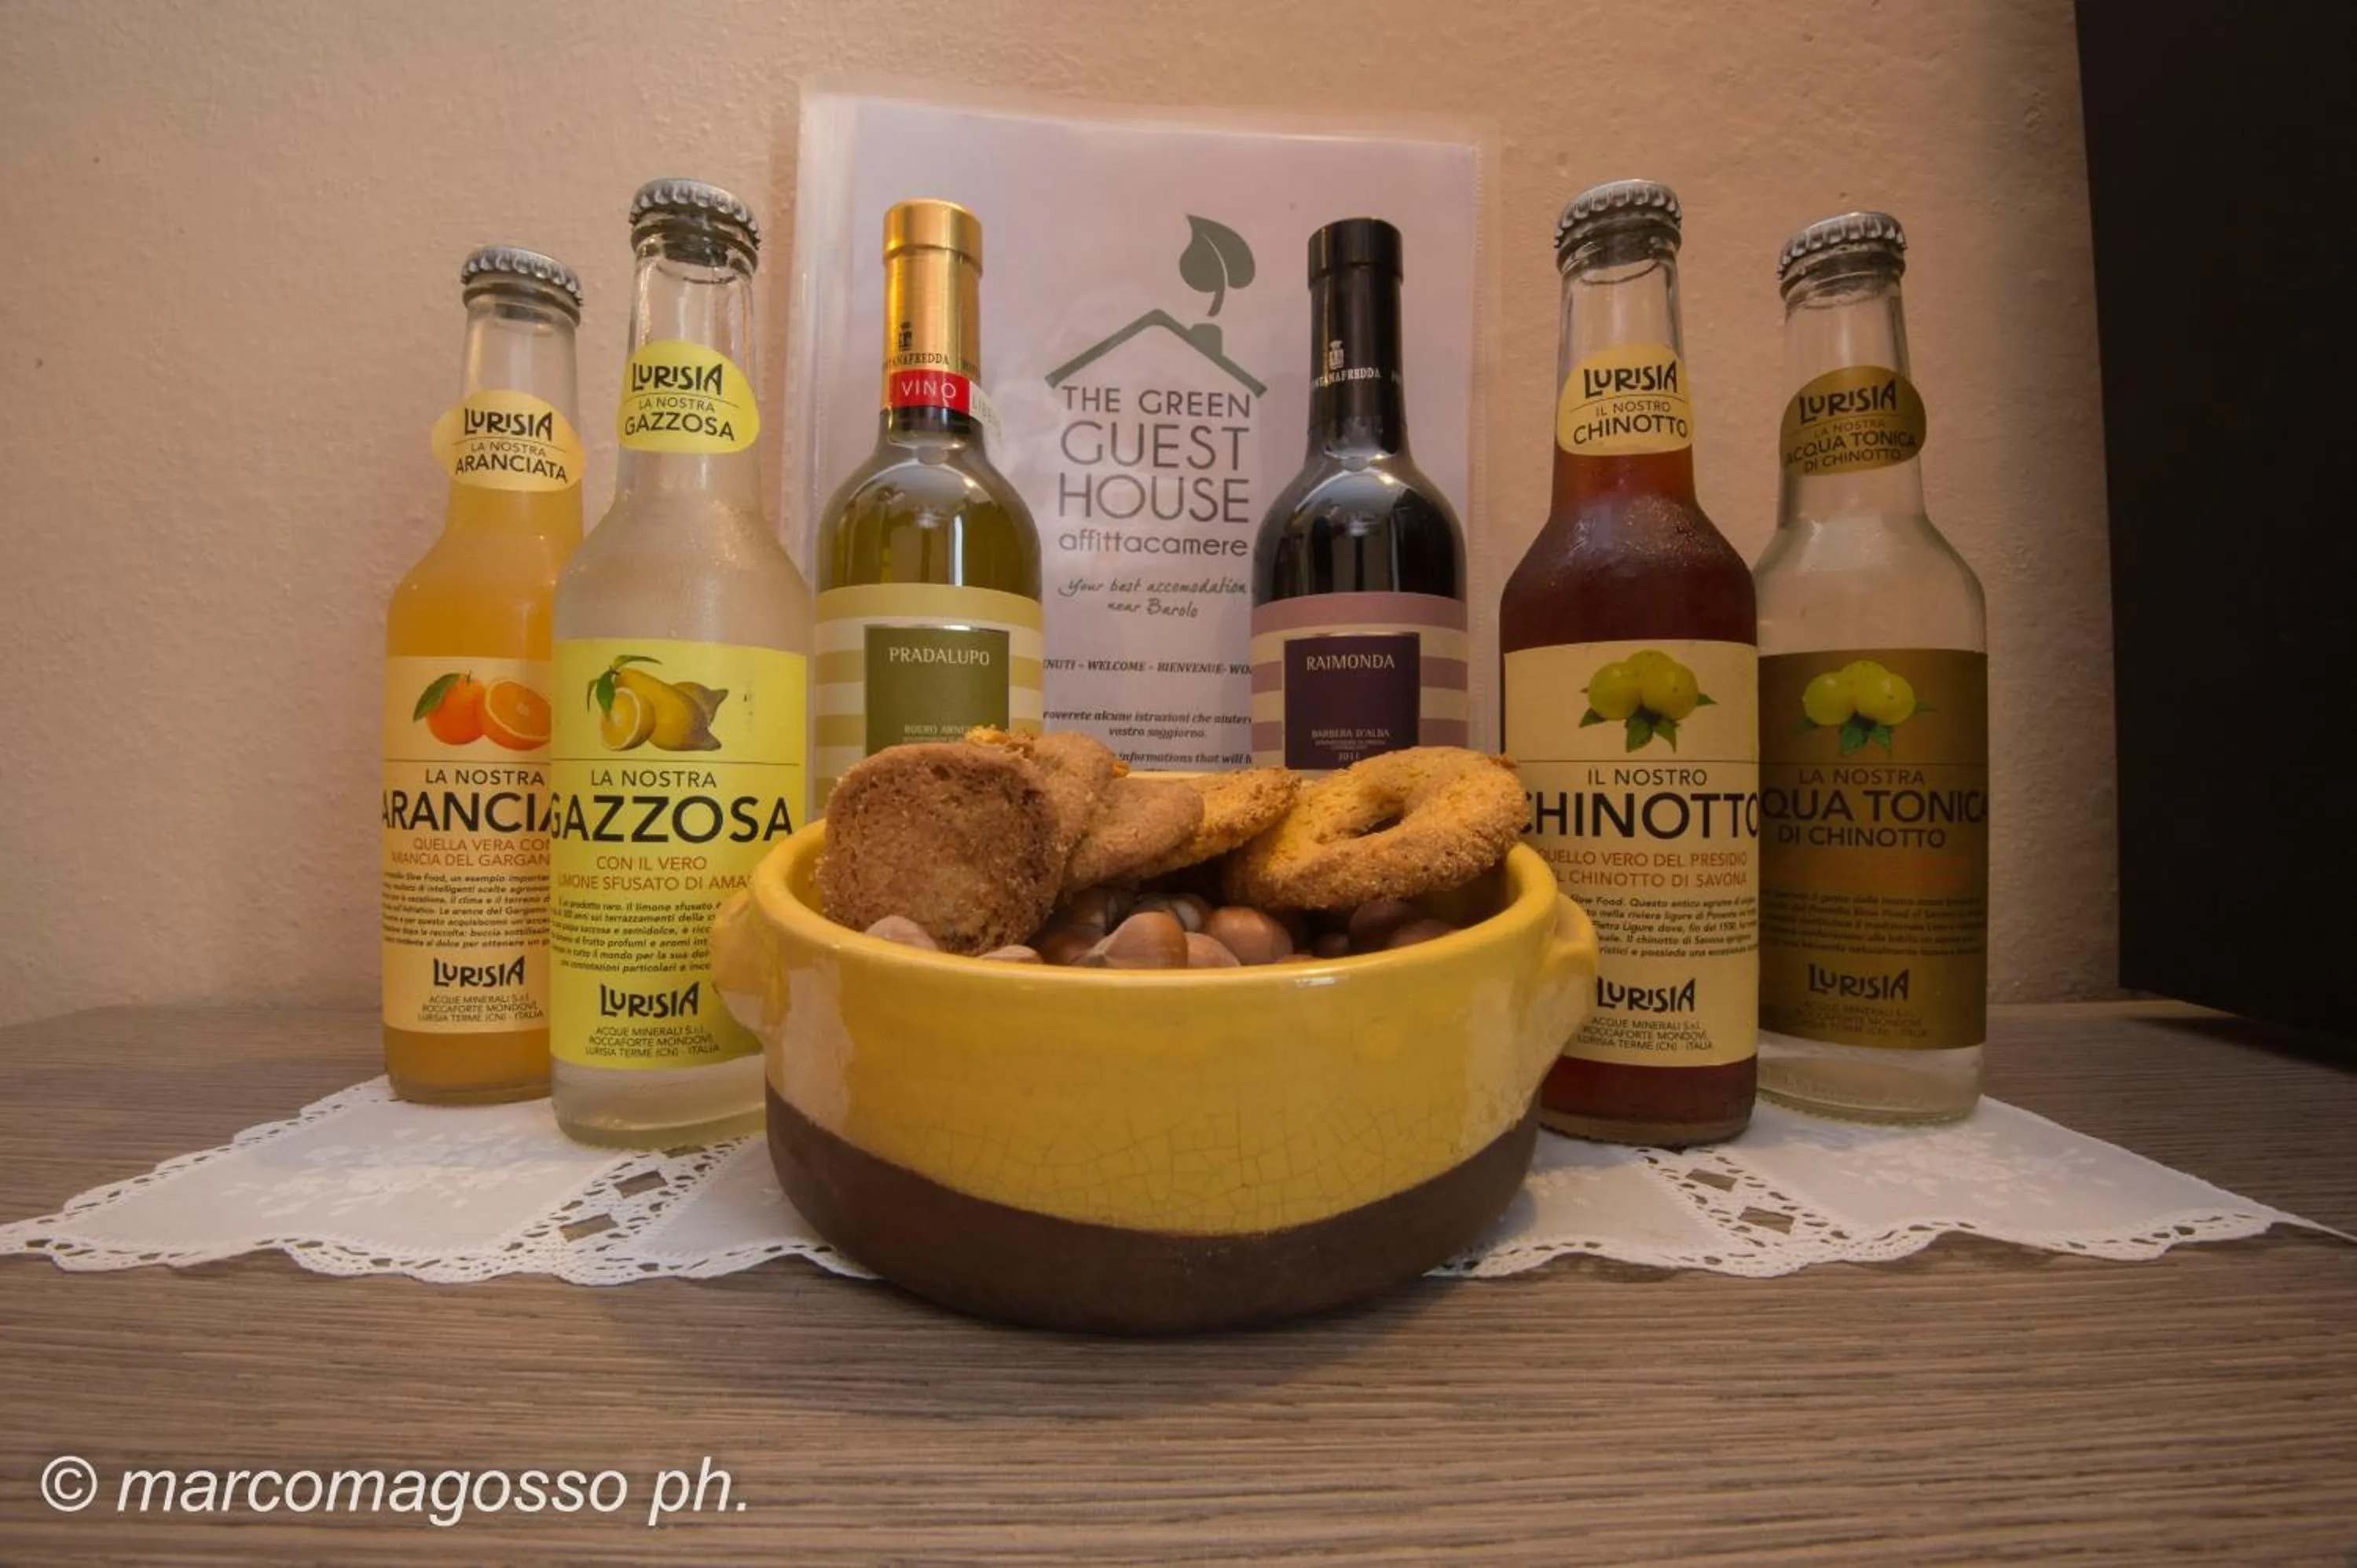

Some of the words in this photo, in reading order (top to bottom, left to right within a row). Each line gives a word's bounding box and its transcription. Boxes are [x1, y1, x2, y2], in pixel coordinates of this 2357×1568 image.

[632, 362, 723, 396] LURISIA
[1583, 360, 1678, 399] LURISIA
[901, 379, 956, 399] VINO
[639, 398, 653, 410] LA
[656, 396, 715, 412] NOSTRA
[1061, 385, 1121, 413] THE
[1138, 390, 1250, 419] GREEN
[1596, 406, 1607, 417] IL
[1613, 401, 1672, 414] NOSTRO
[1799, 378, 1897, 424] LURISIA
[464, 407, 553, 441] LURISIA
[625, 411, 736, 441] GAZZOSA
[1574, 414, 1688, 445] CHINOTTO
[1834, 418, 1886, 434] NOSTRA
[471, 442, 485, 452] LA
[489, 440, 547, 457] NOSTRA
[1061, 420, 1251, 471] GUEST
[1849, 430, 1917, 449] TONICA
[1822, 449, 1901, 467] CHINOTTO
[455, 453, 568, 484] ARANCIATA
[1059, 471, 1250, 523] HOUSE
[1058, 529, 1248, 557] affittacamere
[1110, 578, 1142, 593] best
[1108, 602, 1142, 614] near
[1146, 598, 1199, 618] Barolo
[889, 647, 990, 666] PRADALUPO
[1088, 660, 1146, 672] WELCOME
[1307, 654, 1395, 671] RAIMONDA
[1192, 712, 1211, 724] che
[1195, 752, 1219, 763] that
[1222, 753, 1243, 764] will
[425, 768, 447, 784] LA
[455, 768, 545, 786] NOSTRA
[591, 770, 614, 786] LA
[621, 770, 717, 789] NOSTRA
[1588, 768, 1606, 786] IL
[1614, 768, 1708, 786] NOSTRO
[1799, 769, 1824, 786] LA
[1833, 769, 1925, 786] NOSTRA
[551, 791, 794, 844] GAZZOSA
[413, 837, 468, 852] QUELLA
[471, 837, 515, 852] VERA
[1779, 826, 1801, 845] DI
[1809, 826, 1947, 848] CHINOTTO
[445, 853, 475, 866] DEL
[596, 855, 632, 872] CON
[639, 856, 655, 872] IL
[658, 856, 708, 872] VERO
[1601, 852, 1649, 867] VERO
[1654, 853, 1686, 867] DEL
[1691, 851, 1748, 868] PRESIDIO
[603, 874, 680, 892] SFUSATO
[685, 876, 703, 890] DI
[1569, 870, 1666, 888] CHINOTTO
[1671, 874, 1689, 888] DI
[1695, 871, 1747, 888] SAVONA
[433, 955, 526, 988] LURISIA
[1808, 963, 1911, 1002] LURISIA
[599, 980, 700, 1019] LURISIA
[1596, 975, 1696, 1013] LURISIA
